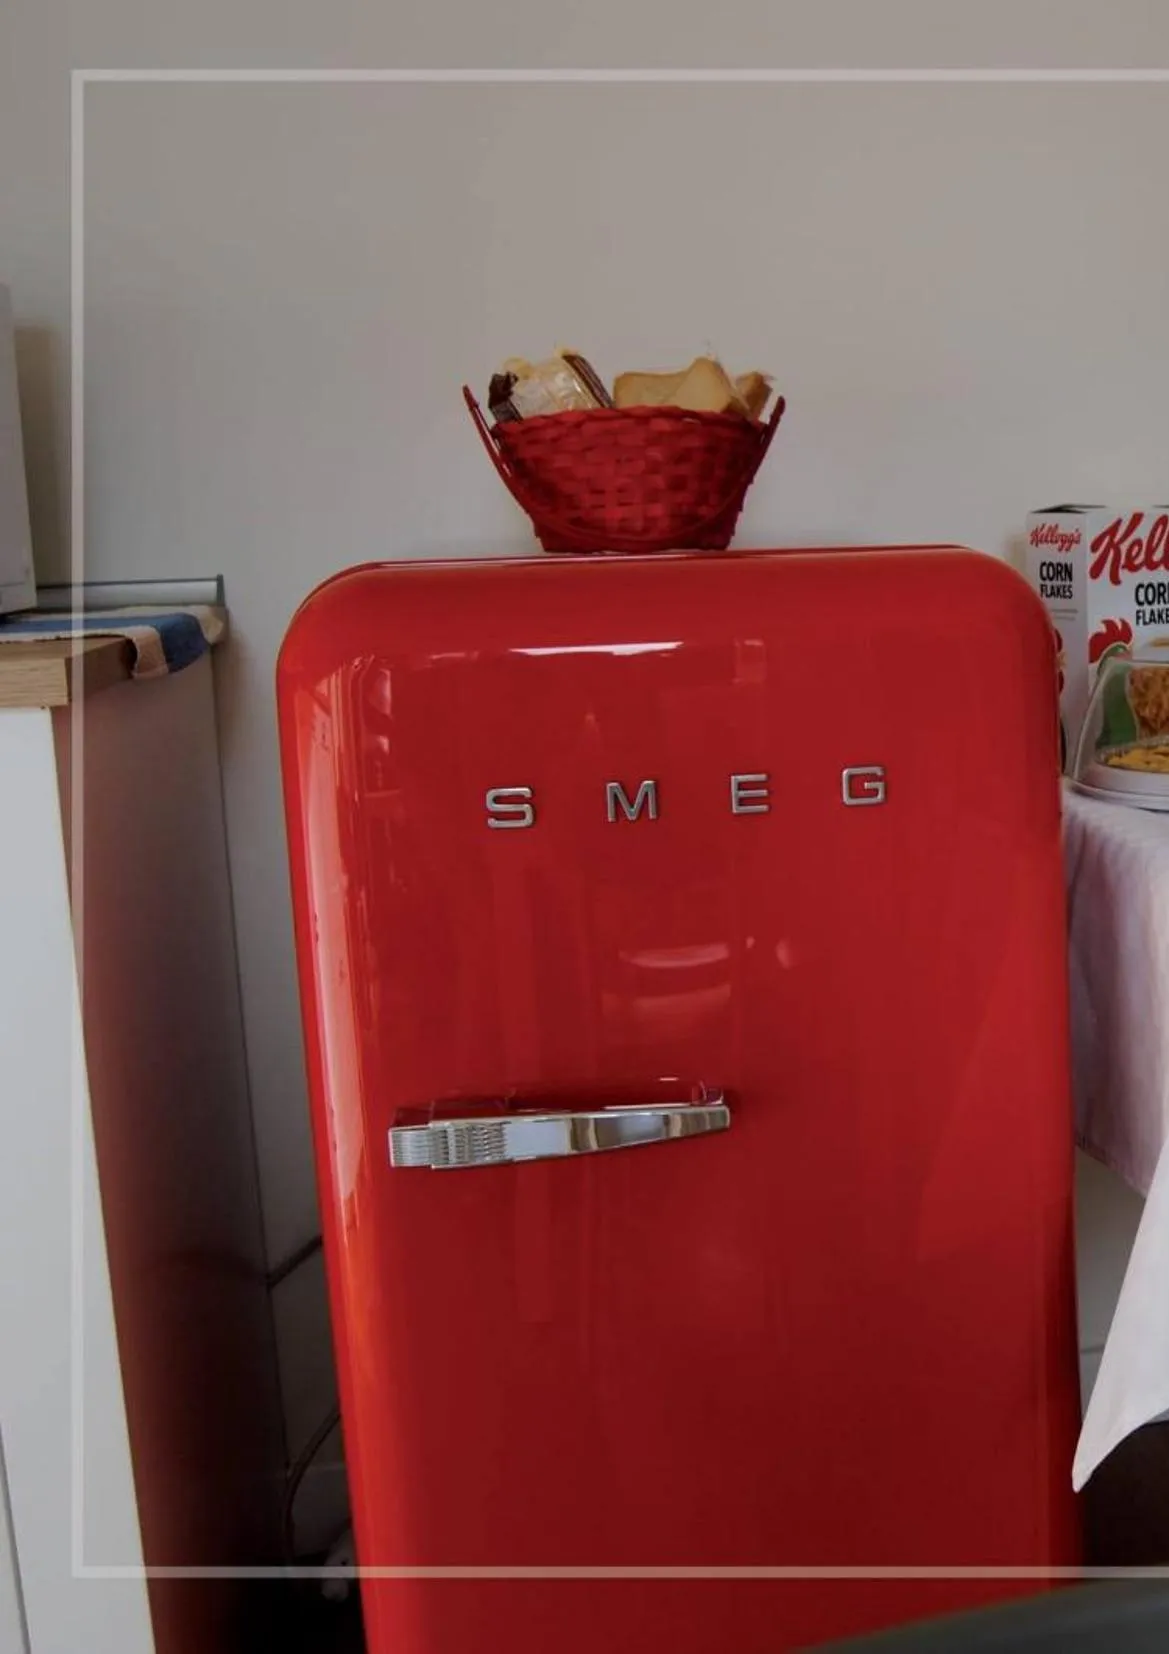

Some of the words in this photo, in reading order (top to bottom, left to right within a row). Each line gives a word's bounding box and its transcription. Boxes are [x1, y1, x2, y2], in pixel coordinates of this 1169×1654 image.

[1030, 523, 1081, 552] Kellogg's
[1039, 561, 1073, 582] CORN
[1040, 584, 1073, 599] FLAKES
